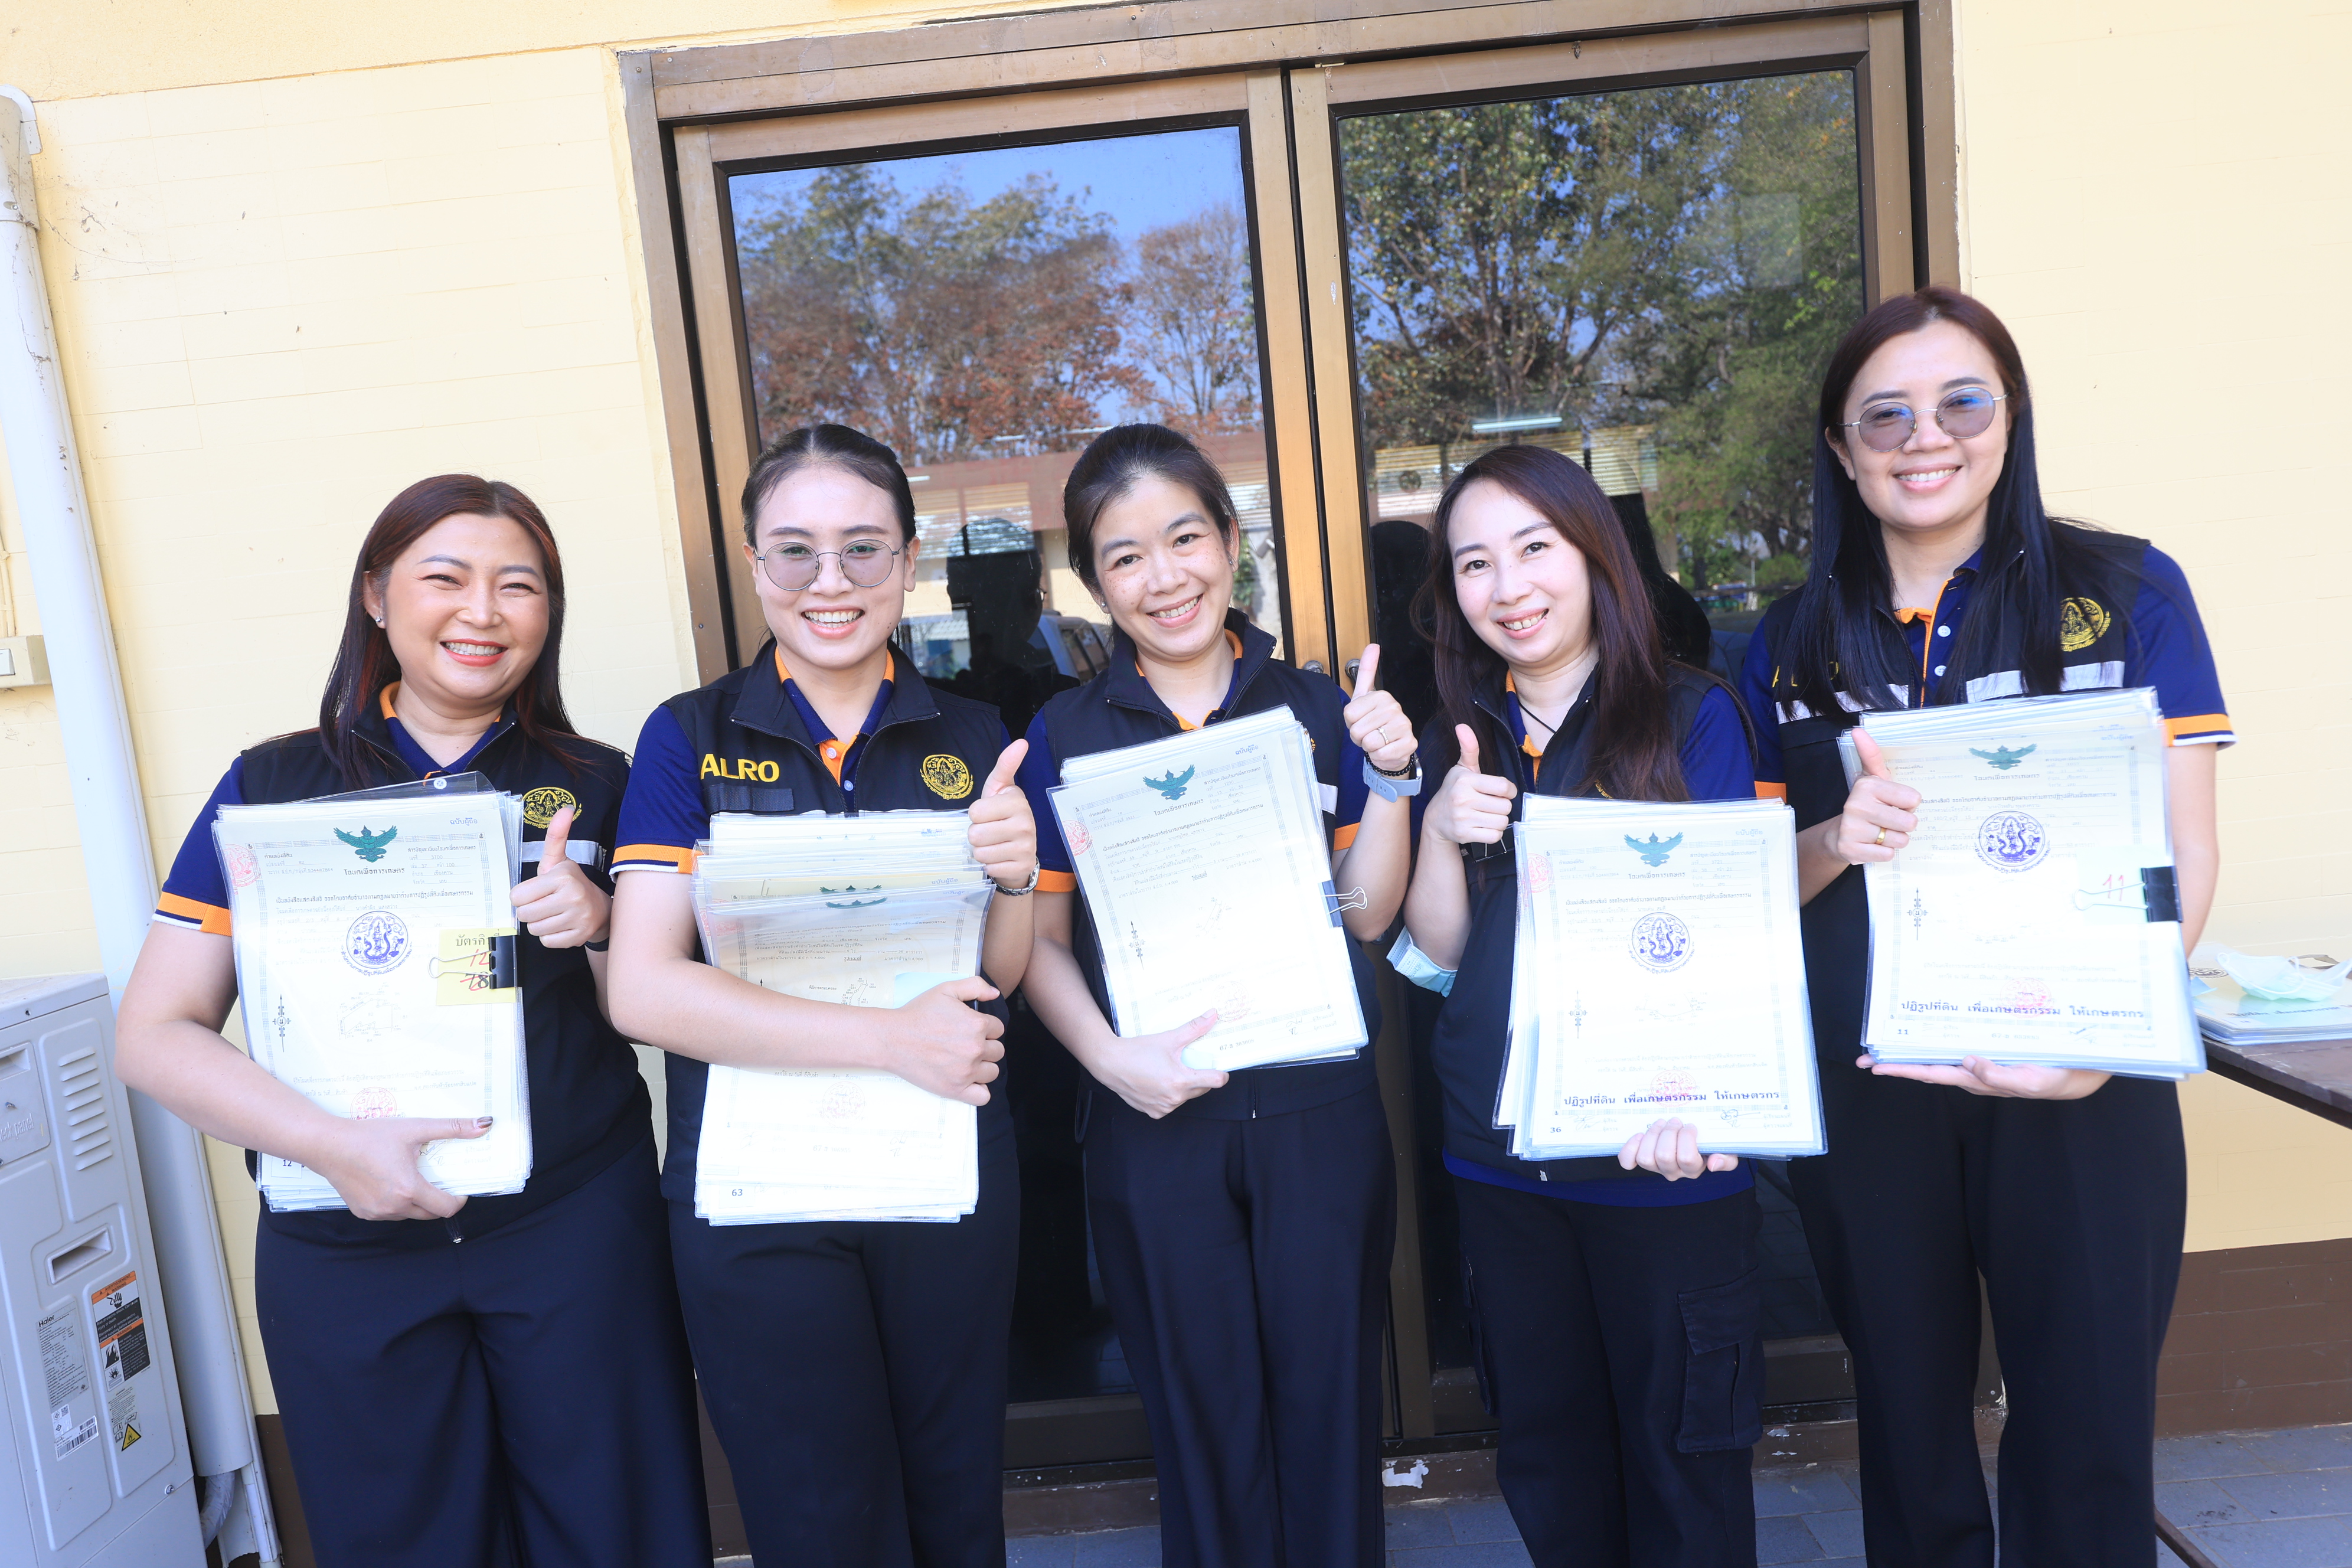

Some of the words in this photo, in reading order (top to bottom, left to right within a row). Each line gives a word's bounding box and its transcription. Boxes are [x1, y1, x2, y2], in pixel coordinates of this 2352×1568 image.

[1235, 744, 1259, 755] ฉบับผู้ถือ
[701, 753, 780, 782] ALRO
[1154, 798, 1204, 816] โฉนดเพื่อการเกษตร
[450, 818, 478, 826] ฉบับผู้ถือ
[1736, 828, 1763, 837] ฉบับผู้ถือ
[344, 866, 405, 876] โฉนดเพื่อการเกษตร
[1628, 870, 1686, 880] โฉนดเพื่อการเกษตร
[2103, 874, 2124, 901] 11
[470, 949, 491, 967] 12
[1901, 999, 1958, 1012] ปฏิรูปที่ดิน
[1968, 1001, 2060, 1014] เพื่อเกษตรกรรม
[2069, 1005, 2144, 1018] ให้เกษตรกร
[1564, 1093, 1616, 1108] ปฏิรูปที่ดิน
[1624, 1092, 1707, 1103] เพื่อเกษตรกรรม
[1714, 1090, 1780, 1100] ให้เกษตรกร
[14, 1112, 34, 1140] panel
[731, 1188, 743, 1197] 63
[112, 1282, 127, 1292] WARNING
[38, 1315, 55, 1328] Haier
[116, 1325, 132, 1337] WARNING
